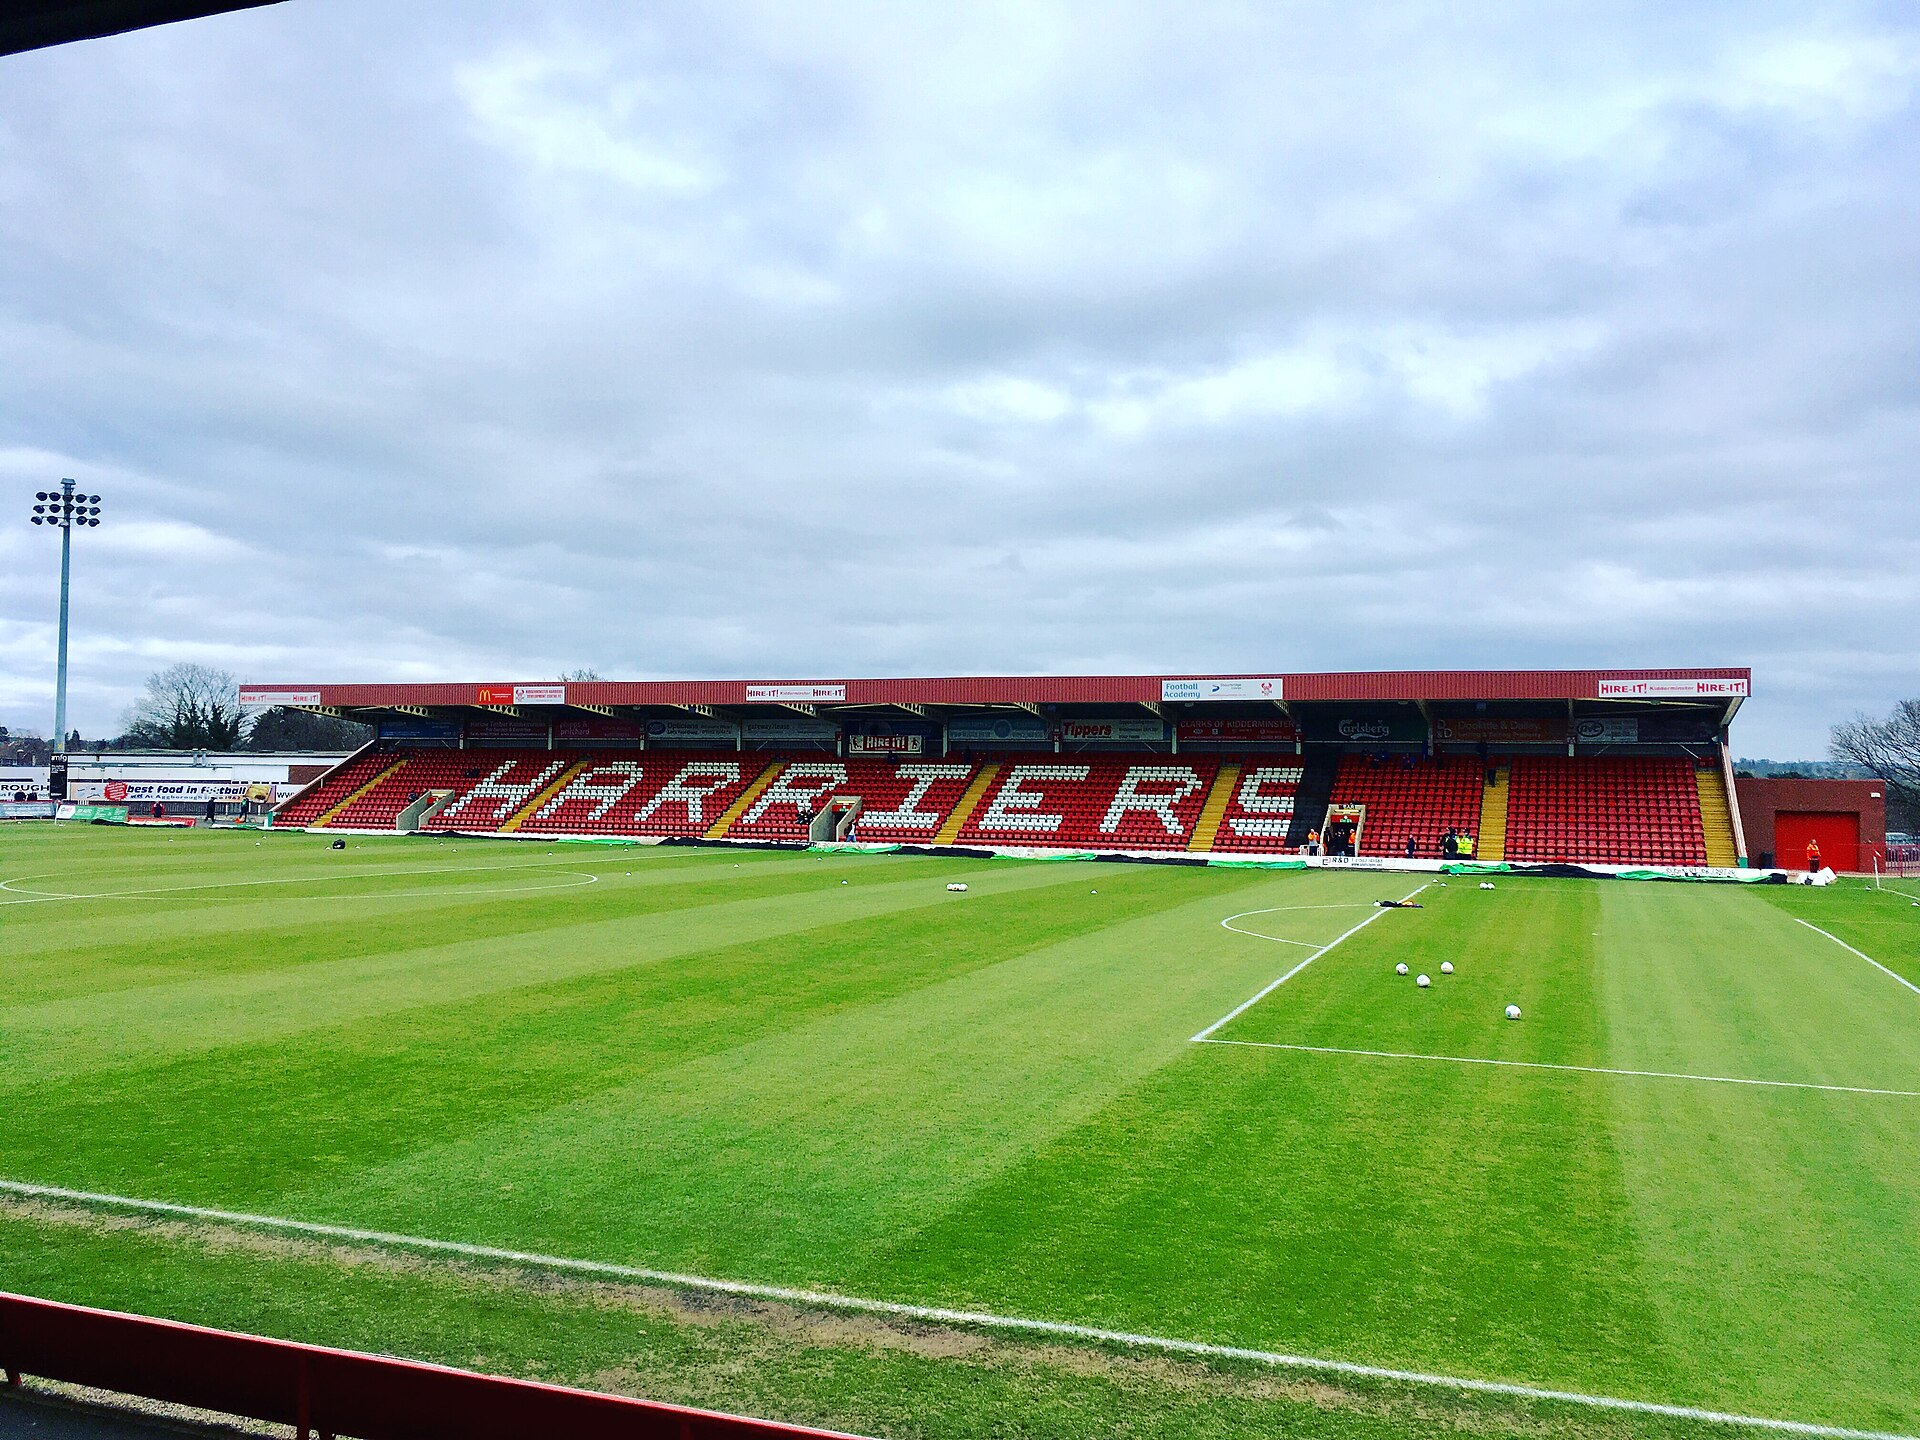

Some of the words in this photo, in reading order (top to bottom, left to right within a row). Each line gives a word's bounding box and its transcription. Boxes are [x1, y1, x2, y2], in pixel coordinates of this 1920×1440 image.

[1601, 683, 1647, 694] HIRE-IT!
[1697, 681, 1745, 693] HIRE-IT!
[747, 689, 779, 697] HIRE-IT!
[813, 688, 845, 697] HIRE-IT!
[1163, 691, 1200, 699] Academy
[241, 694, 267, 703] HIRE-IT!
[292, 694, 319, 702] HIRE-IT!
[1180, 720, 1212, 728] CLARKS
[1214, 720, 1224, 728] OF
[1227, 720, 1294, 728] KIDDERMINSTER
[1338, 719, 1390, 738] Carlsberg
[1064, 721, 1112, 738] Tippers
[866, 736, 890, 748] HIRE
[891, 736, 905, 749] IT!
[127, 785, 154, 794] best
[157, 785, 183, 794] food
[186, 785, 198, 794] in
